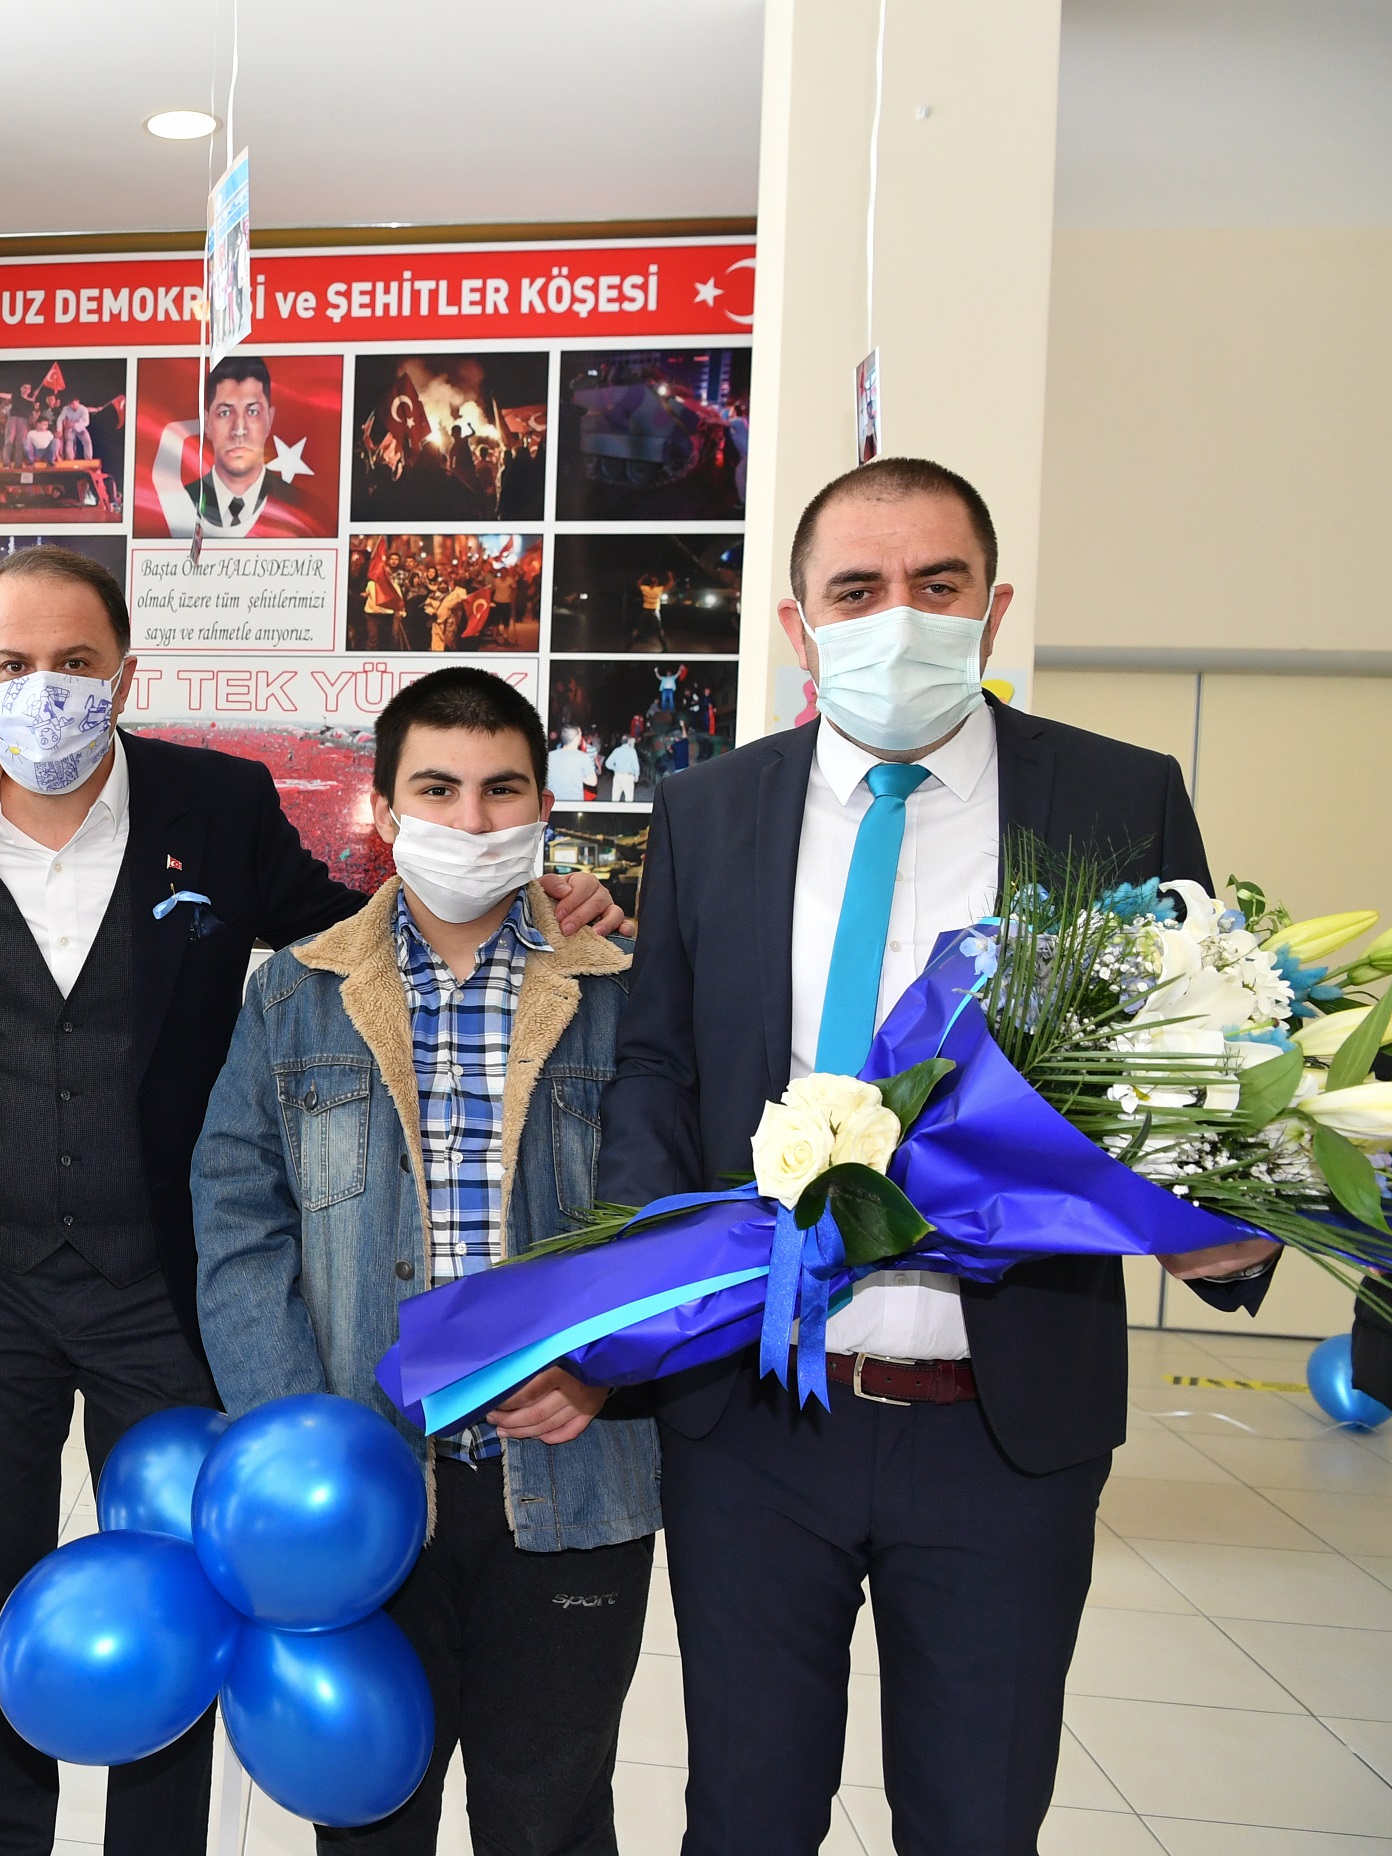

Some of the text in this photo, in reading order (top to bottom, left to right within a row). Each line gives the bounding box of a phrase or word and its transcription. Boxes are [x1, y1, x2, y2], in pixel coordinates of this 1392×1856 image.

[54, 275, 266, 323] DEMOKRİ
[275, 287, 317, 319] ve
[325, 270, 509, 324] ŞEHİTLER
[519, 263, 658, 319] KÖŞESİ
[141, 554, 326, 581] Başta Ömer HALİSDEMİR
[137, 588, 326, 613] olmak üzere tüm şehitlerimizi
[145, 621, 314, 647] saygı ve rahmetle anıyoruz.
[177, 669, 298, 712] TEK
